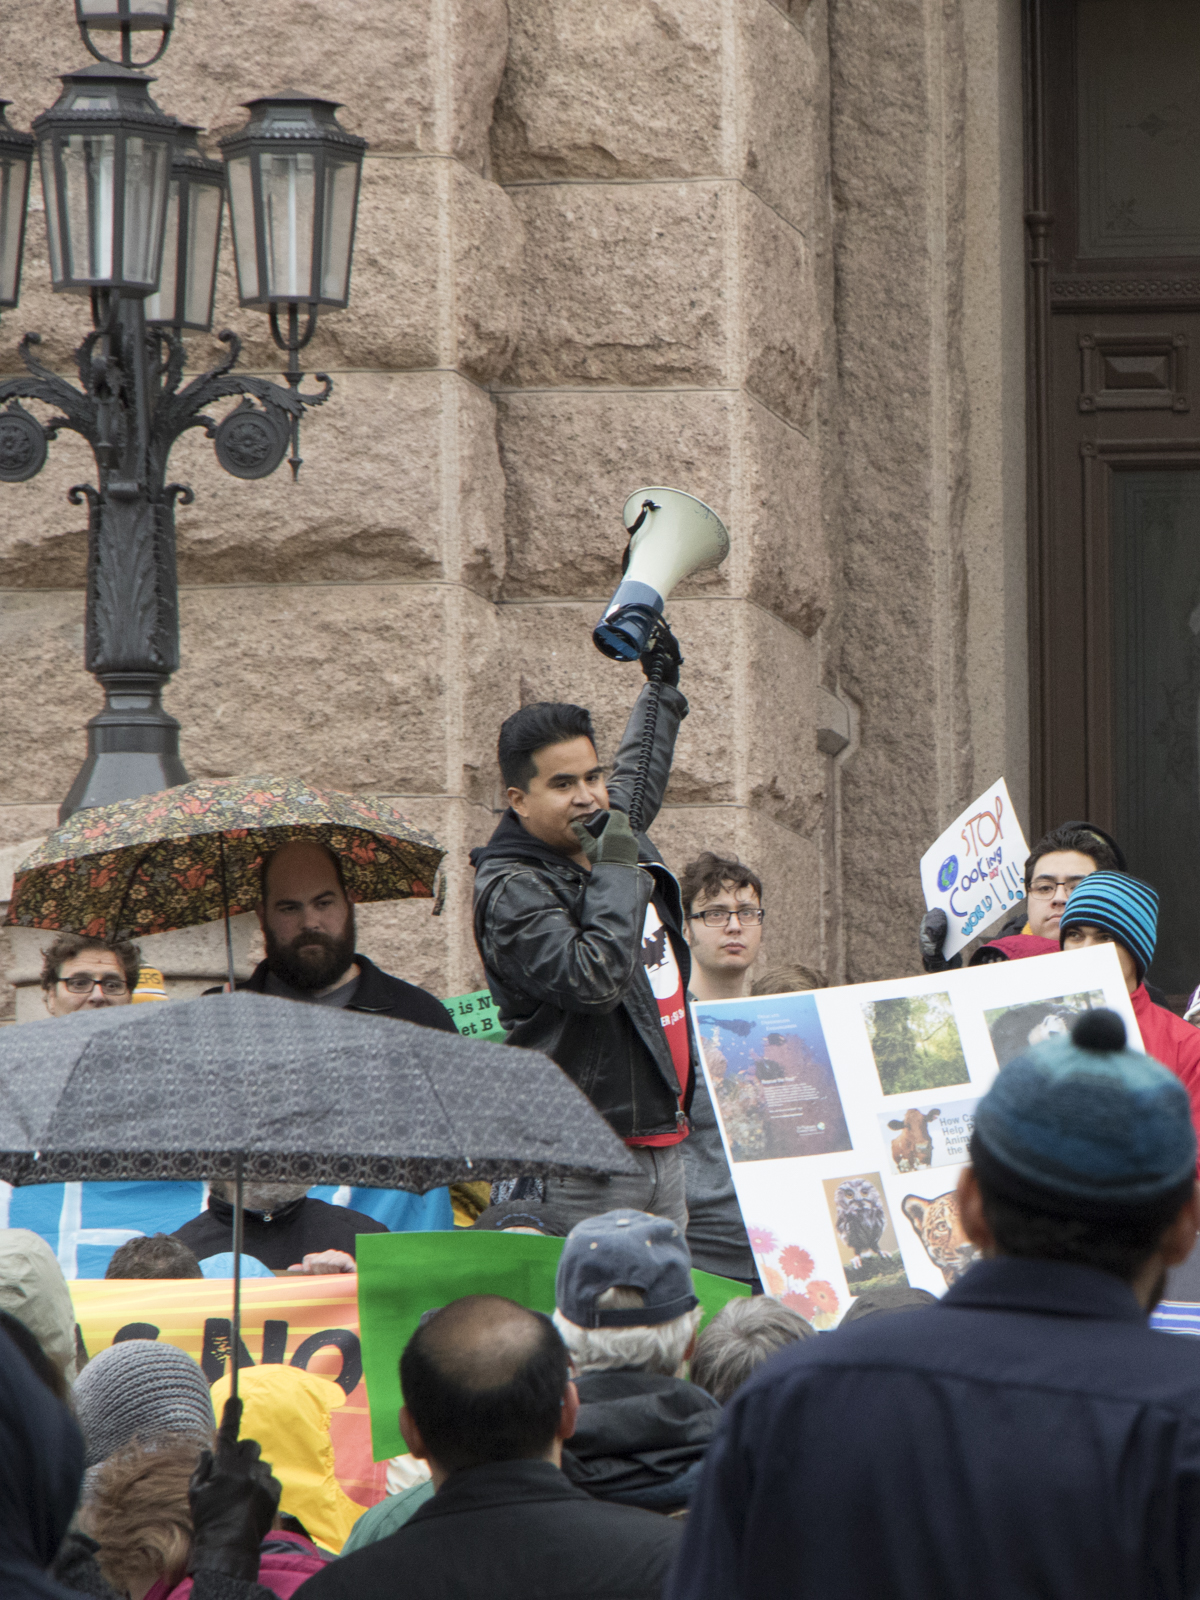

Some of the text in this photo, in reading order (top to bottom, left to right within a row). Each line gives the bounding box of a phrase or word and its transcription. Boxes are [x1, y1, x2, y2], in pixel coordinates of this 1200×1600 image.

[961, 796, 1004, 857] STOP
[138, 972, 161, 984] ERS
[458, 1001, 474, 1015] is
[480, 1017, 493, 1032] B
[940, 1115, 959, 1127] How
[942, 1125, 964, 1136] Help
[945, 1135, 971, 1146] Anim
[947, 1145, 963, 1156] the
